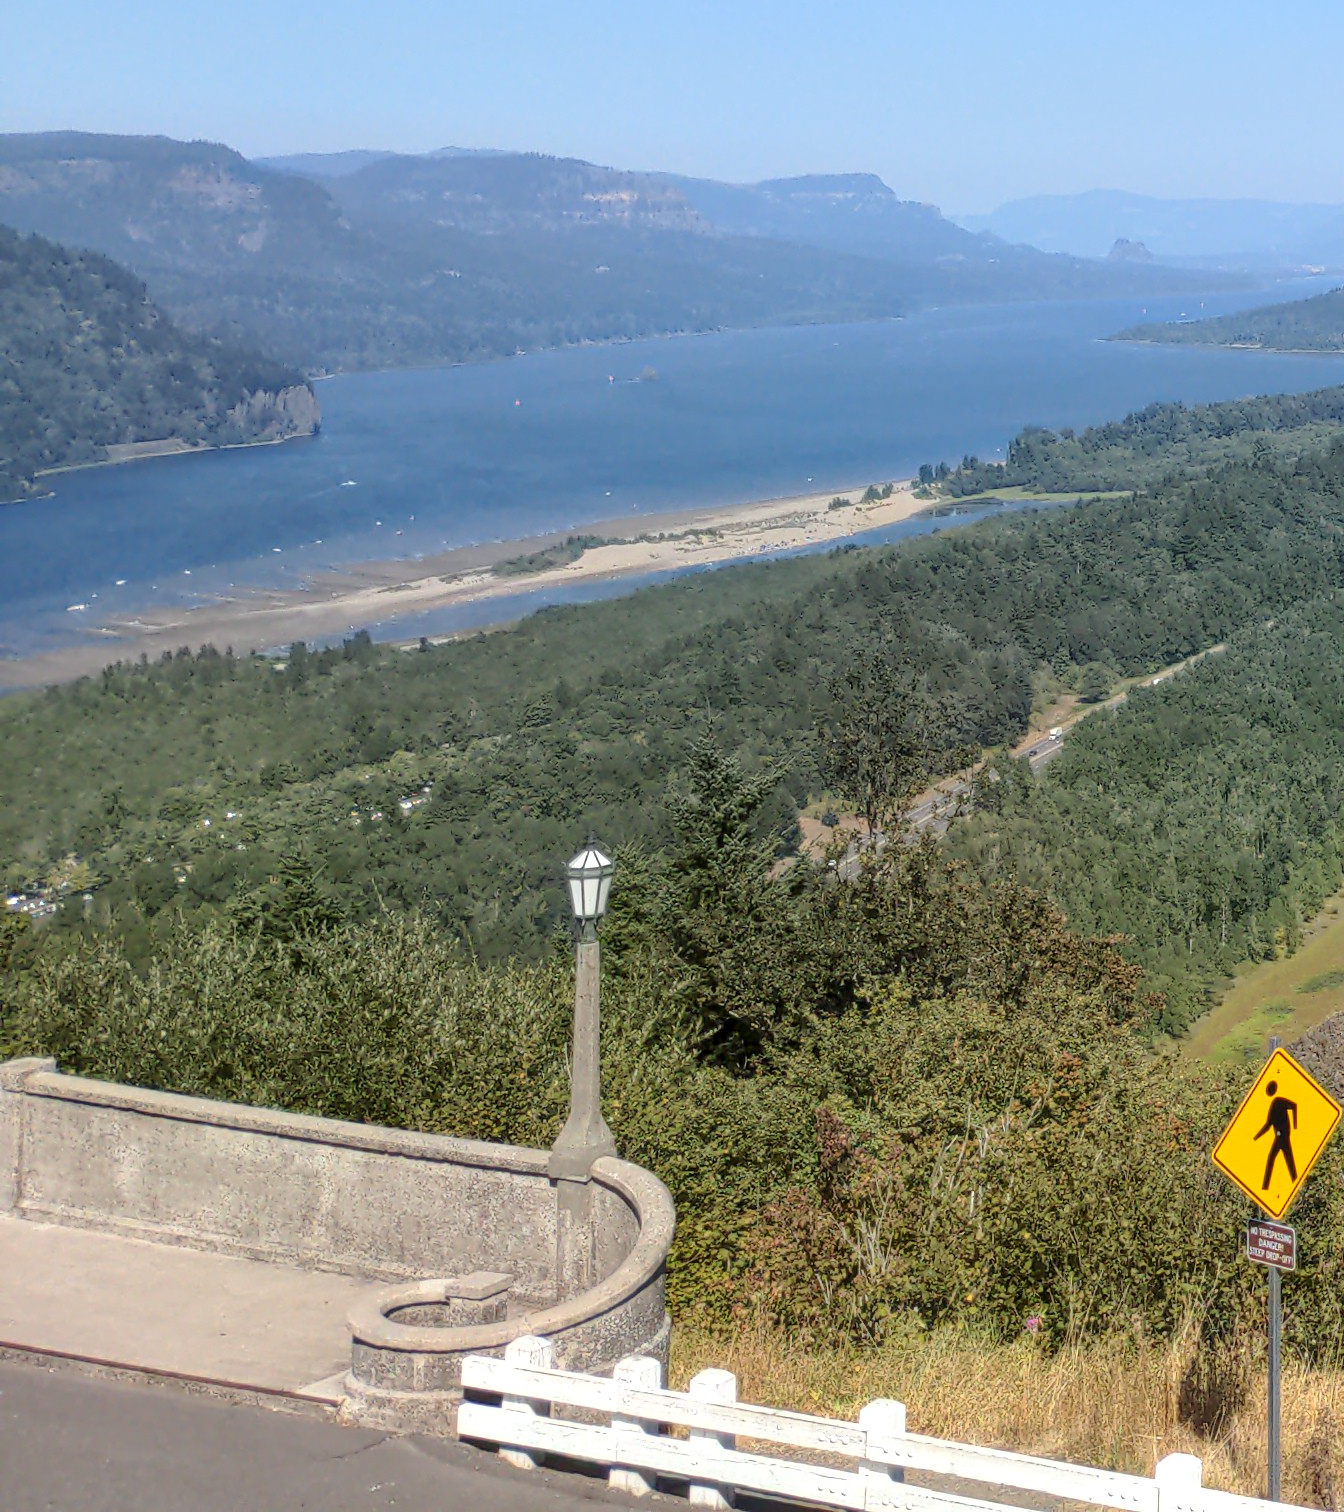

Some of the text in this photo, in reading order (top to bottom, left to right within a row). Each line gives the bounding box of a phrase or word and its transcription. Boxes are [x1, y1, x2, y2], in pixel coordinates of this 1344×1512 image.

[1250, 1226, 1292, 1244] NO TRESPASSING
[1249, 1246, 1265, 1257] STEEP
